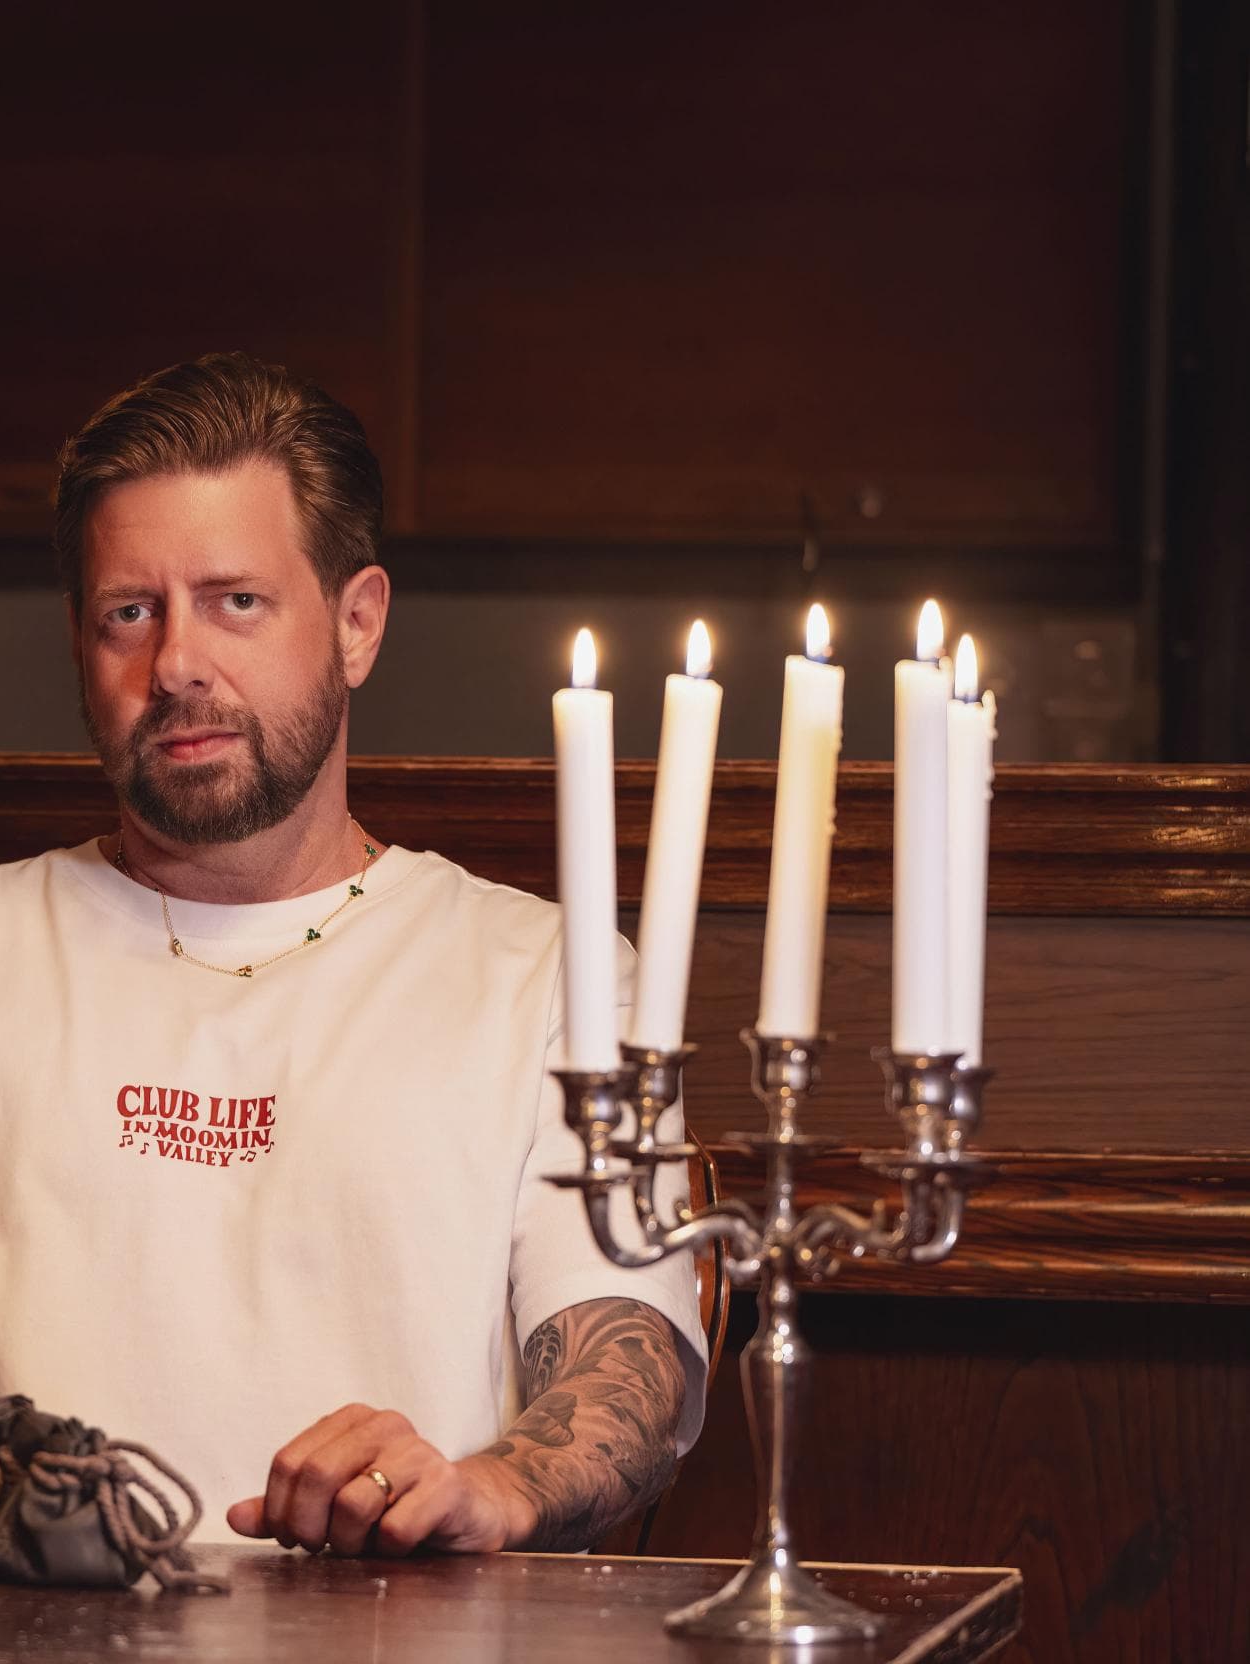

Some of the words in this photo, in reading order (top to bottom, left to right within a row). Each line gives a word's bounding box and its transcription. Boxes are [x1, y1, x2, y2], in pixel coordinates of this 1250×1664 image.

[117, 1085, 199, 1121] CLUB
[208, 1095, 276, 1129] LIFE
[123, 1120, 151, 1133] IN
[152, 1120, 271, 1149] MOOMIN
[157, 1140, 234, 1167] VALLEY
